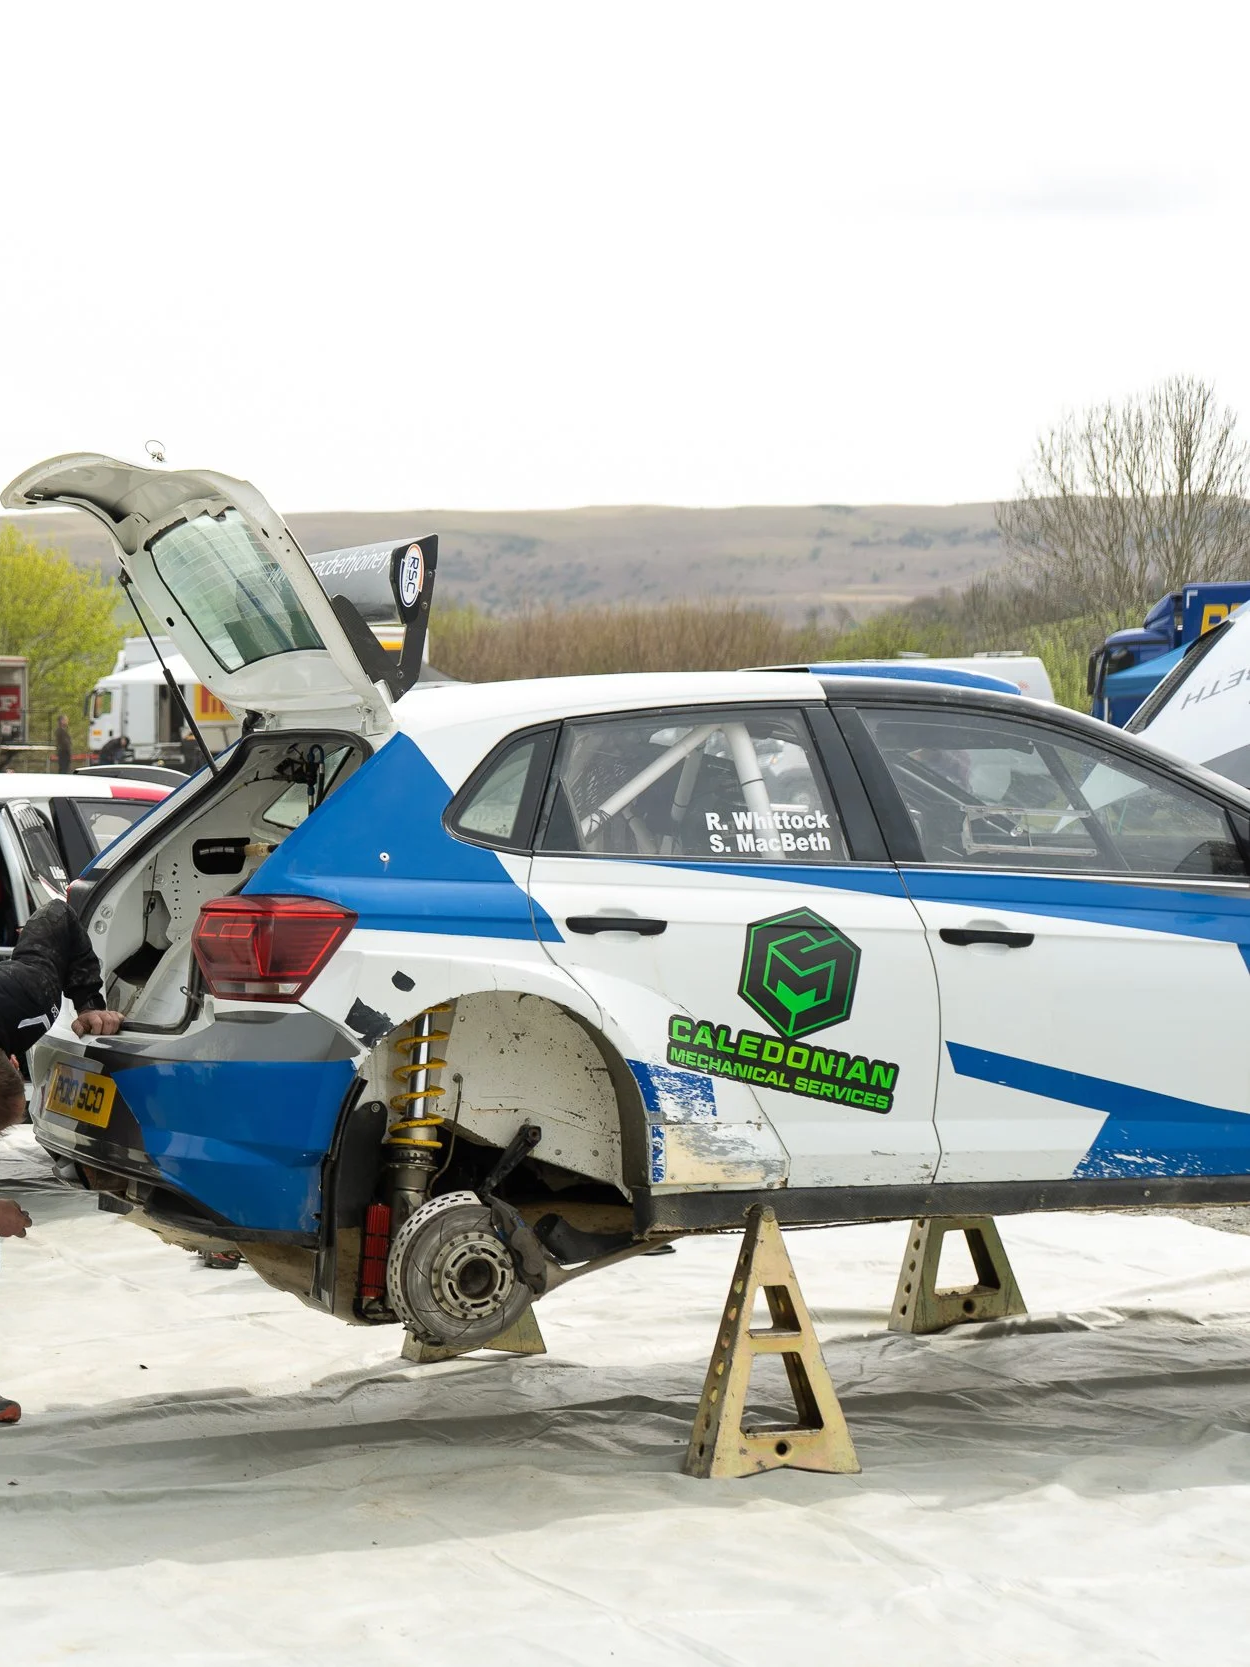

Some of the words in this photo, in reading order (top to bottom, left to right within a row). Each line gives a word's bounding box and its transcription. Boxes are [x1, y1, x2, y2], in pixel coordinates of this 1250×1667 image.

[407, 557, 419, 593] RSC
[705, 812, 728, 831] R.
[732, 810, 830, 830] Whittock
[709, 834, 731, 852] S.
[736, 832, 831, 852] MacBeth
[671, 1019, 894, 1089] CALEDONIAN
[670, 1046, 790, 1088] MECHANICAL
[794, 1079, 889, 1109] SERVICES
[77, 1082, 104, 1113] SCO
